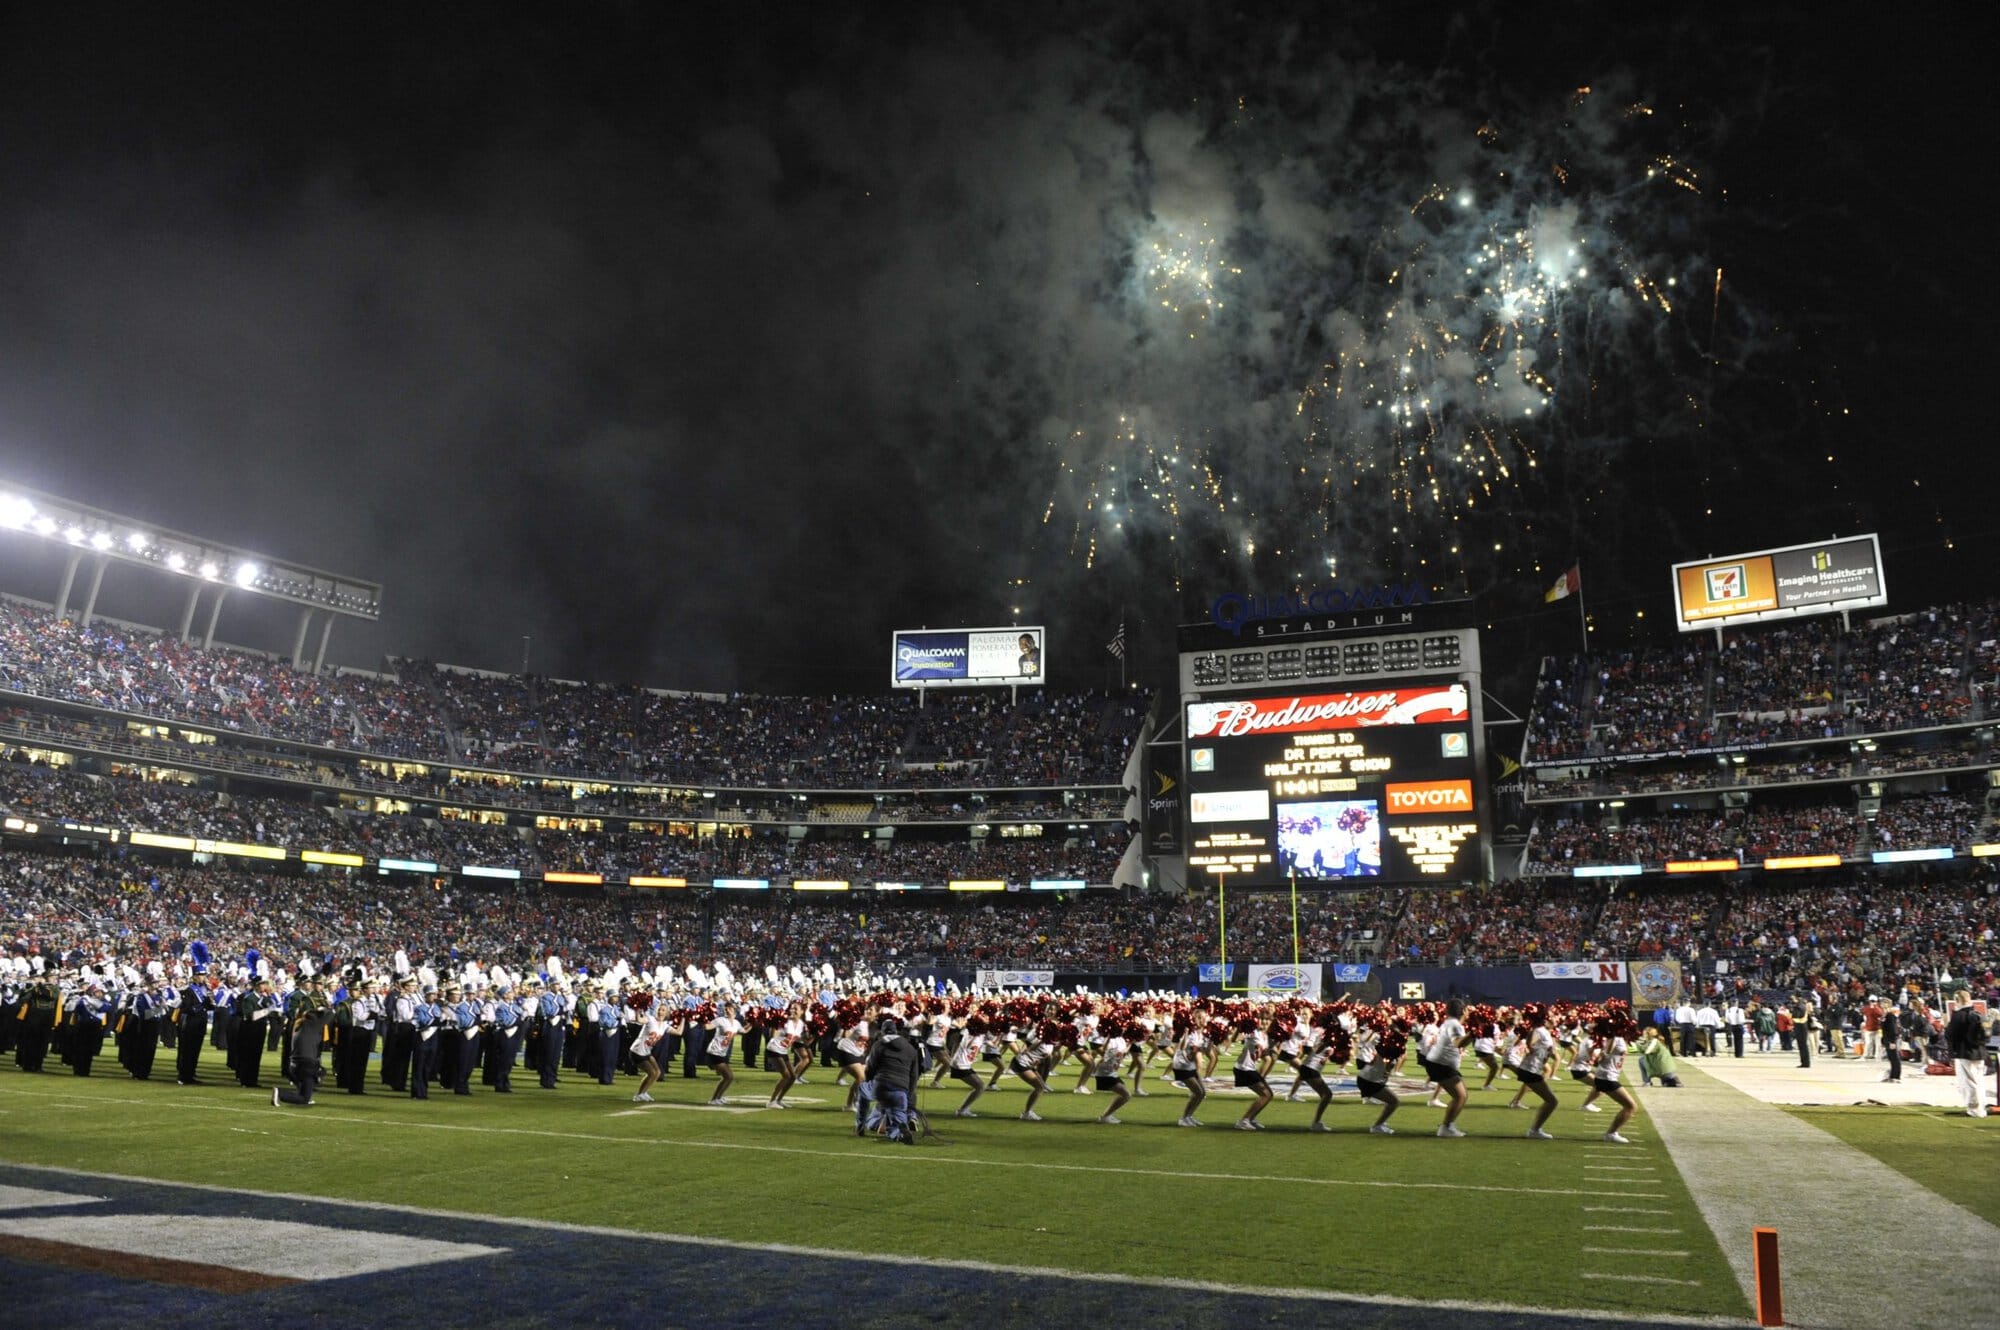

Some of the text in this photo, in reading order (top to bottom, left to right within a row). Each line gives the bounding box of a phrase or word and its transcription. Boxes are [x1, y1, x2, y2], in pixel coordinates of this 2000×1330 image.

[1778, 566, 1874, 587] Imaging Healthcare
[1785, 584, 1868, 601] Your Partner in Health
[1212, 583, 1431, 636] QUALCOMM
[1257, 612, 1413, 636] STADIUM
[900, 647, 966, 663] QUALCOMM
[1212, 692, 1397, 736] Budweiser
[1293, 733, 1355, 746] THANKS TO
[1284, 744, 1365, 761] DR PEPPER
[1264, 757, 1391, 776] HALFTIME SHOW
[1150, 798, 1178, 810] Sprint
[1390, 788, 1469, 807] TOYOTA
[982, 971, 998, 987] A
[1599, 963, 1620, 982] N
